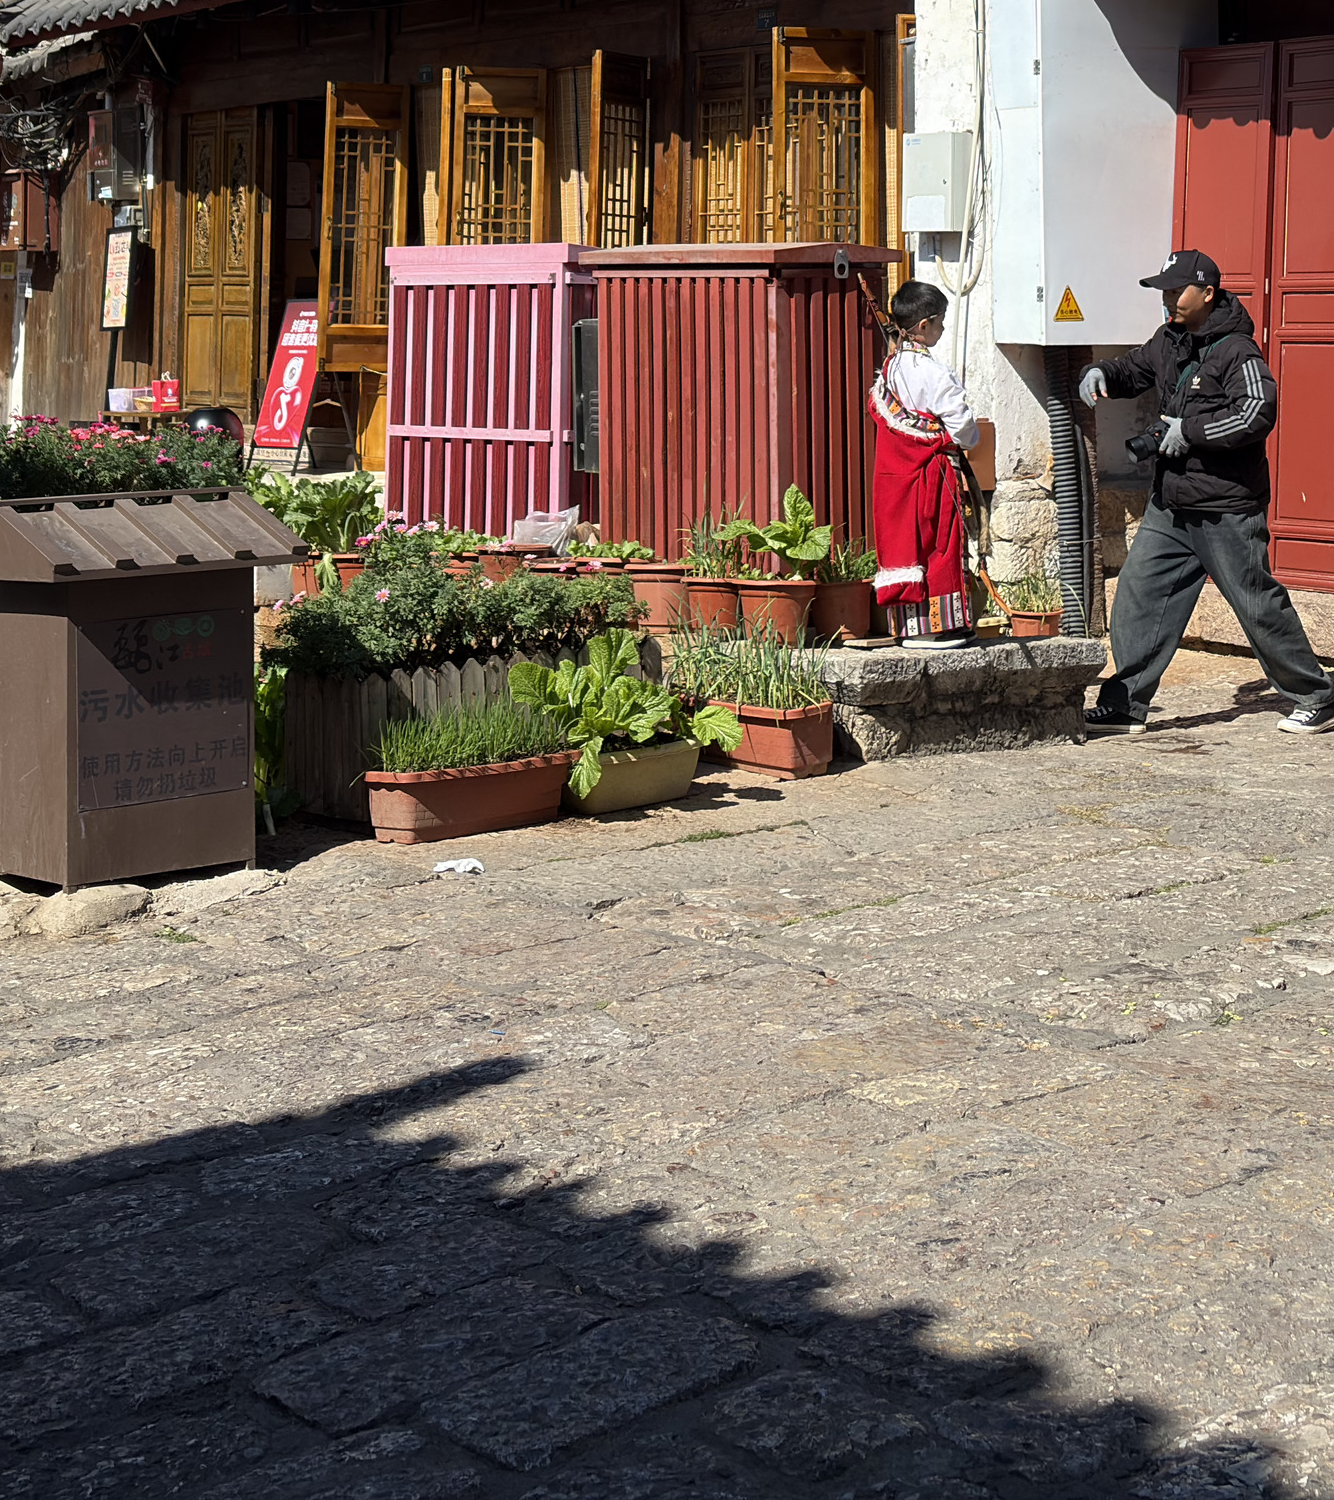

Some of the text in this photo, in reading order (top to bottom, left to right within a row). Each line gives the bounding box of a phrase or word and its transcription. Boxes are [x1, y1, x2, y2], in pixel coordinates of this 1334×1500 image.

[79, 671, 247, 724] 污水收集池
[81, 736, 247, 779] 使用方法向上开启
[113, 766, 217, 801] 请勿扔垃圾
